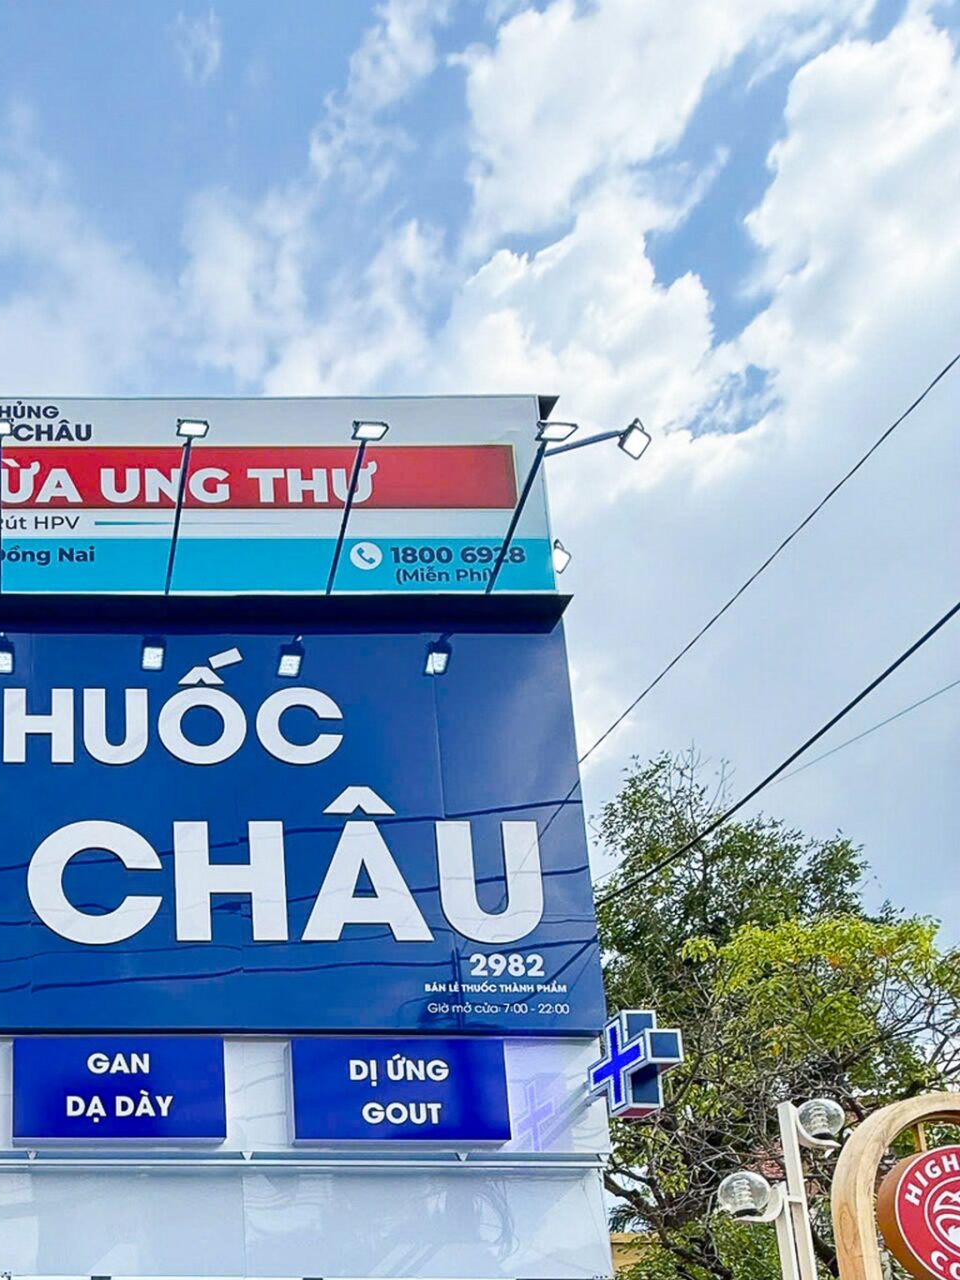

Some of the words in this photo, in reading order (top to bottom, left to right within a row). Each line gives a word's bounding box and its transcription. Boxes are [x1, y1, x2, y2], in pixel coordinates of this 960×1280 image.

[13, 419, 92, 442] CHÂU
[100, 466, 231, 504] UNG
[247, 461, 378, 504] THƯ
[34, 516, 80, 531] HPV
[58, 546, 95, 562] Nai
[390, 546, 454, 564] 1800
[460, 546, 526, 564] 6928
[396, 566, 450, 584] (Miễn
[26, 785, 544, 944] CHÂU
[469, 953, 545, 977] 2982
[424, 981, 447, 993] BÁN
[448, 980, 460, 993] LẺ
[461, 980, 497, 993] THUỐC
[499, 980, 535, 993] THÀNH
[537, 979, 568, 993] PHẨM
[427, 1002, 449, 1014] Giờ
[451, 1001, 472, 1014] mở
[474, 1001, 501, 1014] cửa:
[503, 1003, 528, 1014] 7:00
[538, 1003, 570, 1015] 22:00
[86, 1052, 151, 1075] GAN
[348, 1059, 378, 1087] DỊ
[386, 1053, 450, 1082] ỨNG
[66, 1095, 106, 1124] DẠ
[114, 1090, 174, 1118] DÀY
[361, 1102, 442, 1126] GOUT
